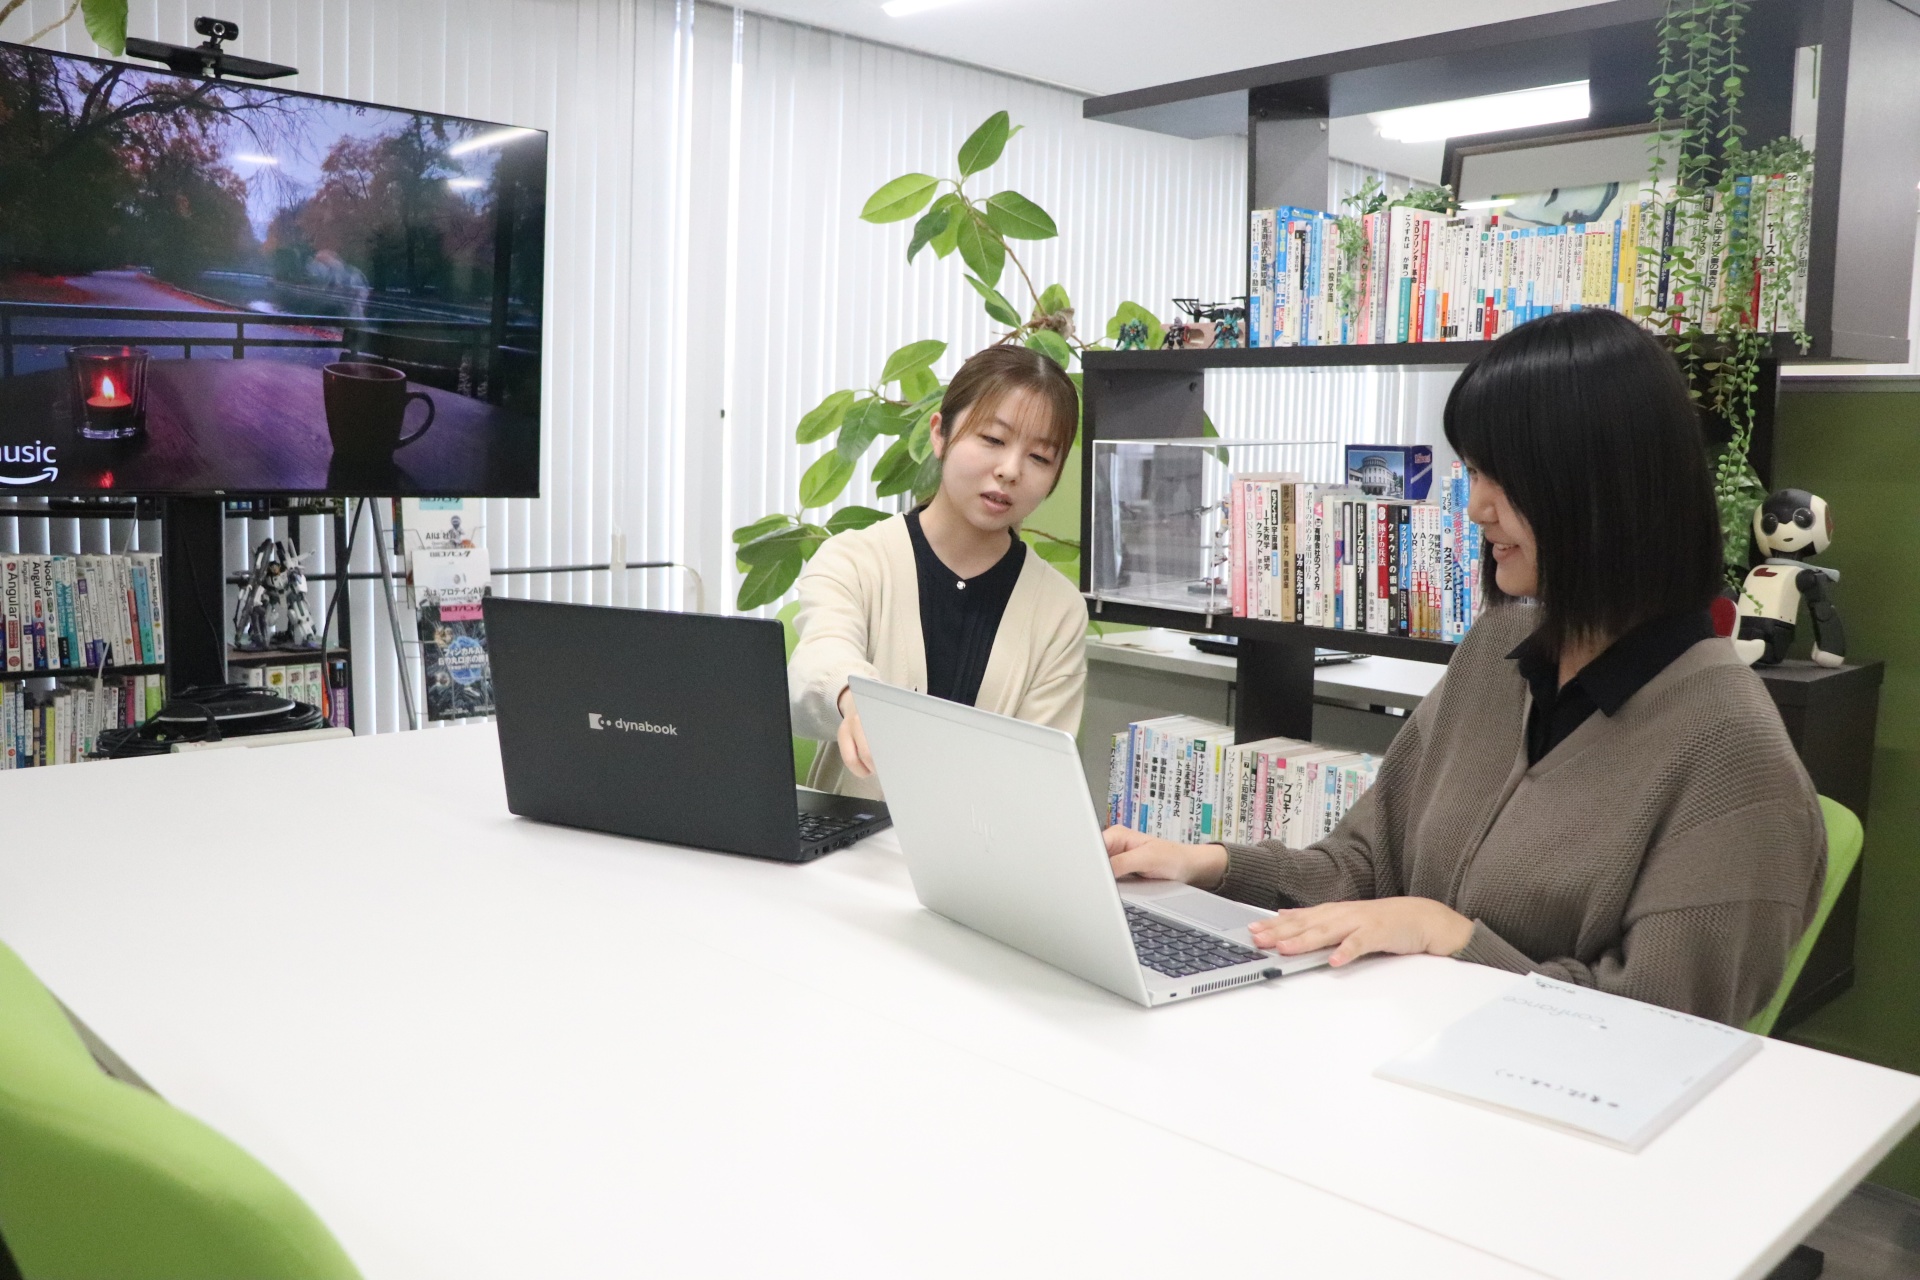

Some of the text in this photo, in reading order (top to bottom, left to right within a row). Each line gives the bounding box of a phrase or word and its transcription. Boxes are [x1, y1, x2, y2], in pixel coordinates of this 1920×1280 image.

[1403, 214, 1412, 249] こうすれば
[1411, 219, 1420, 284] 3Dプリンター革命
[1402, 257, 1411, 276] が育つ
[0, 440, 57, 463] usic
[44, 560, 53, 597] Node.js
[1387, 523, 1398, 595] クラウドの衝撃
[1443, 547, 1453, 591] カメラシステム
[6, 572, 18, 619] Angular
[31, 562, 43, 599] Angular
[615, 717, 678, 735] dynabook
[1173, 761, 1183, 818] トヨタ生産方式
[1239, 771, 1250, 824] 人工知能の世界
